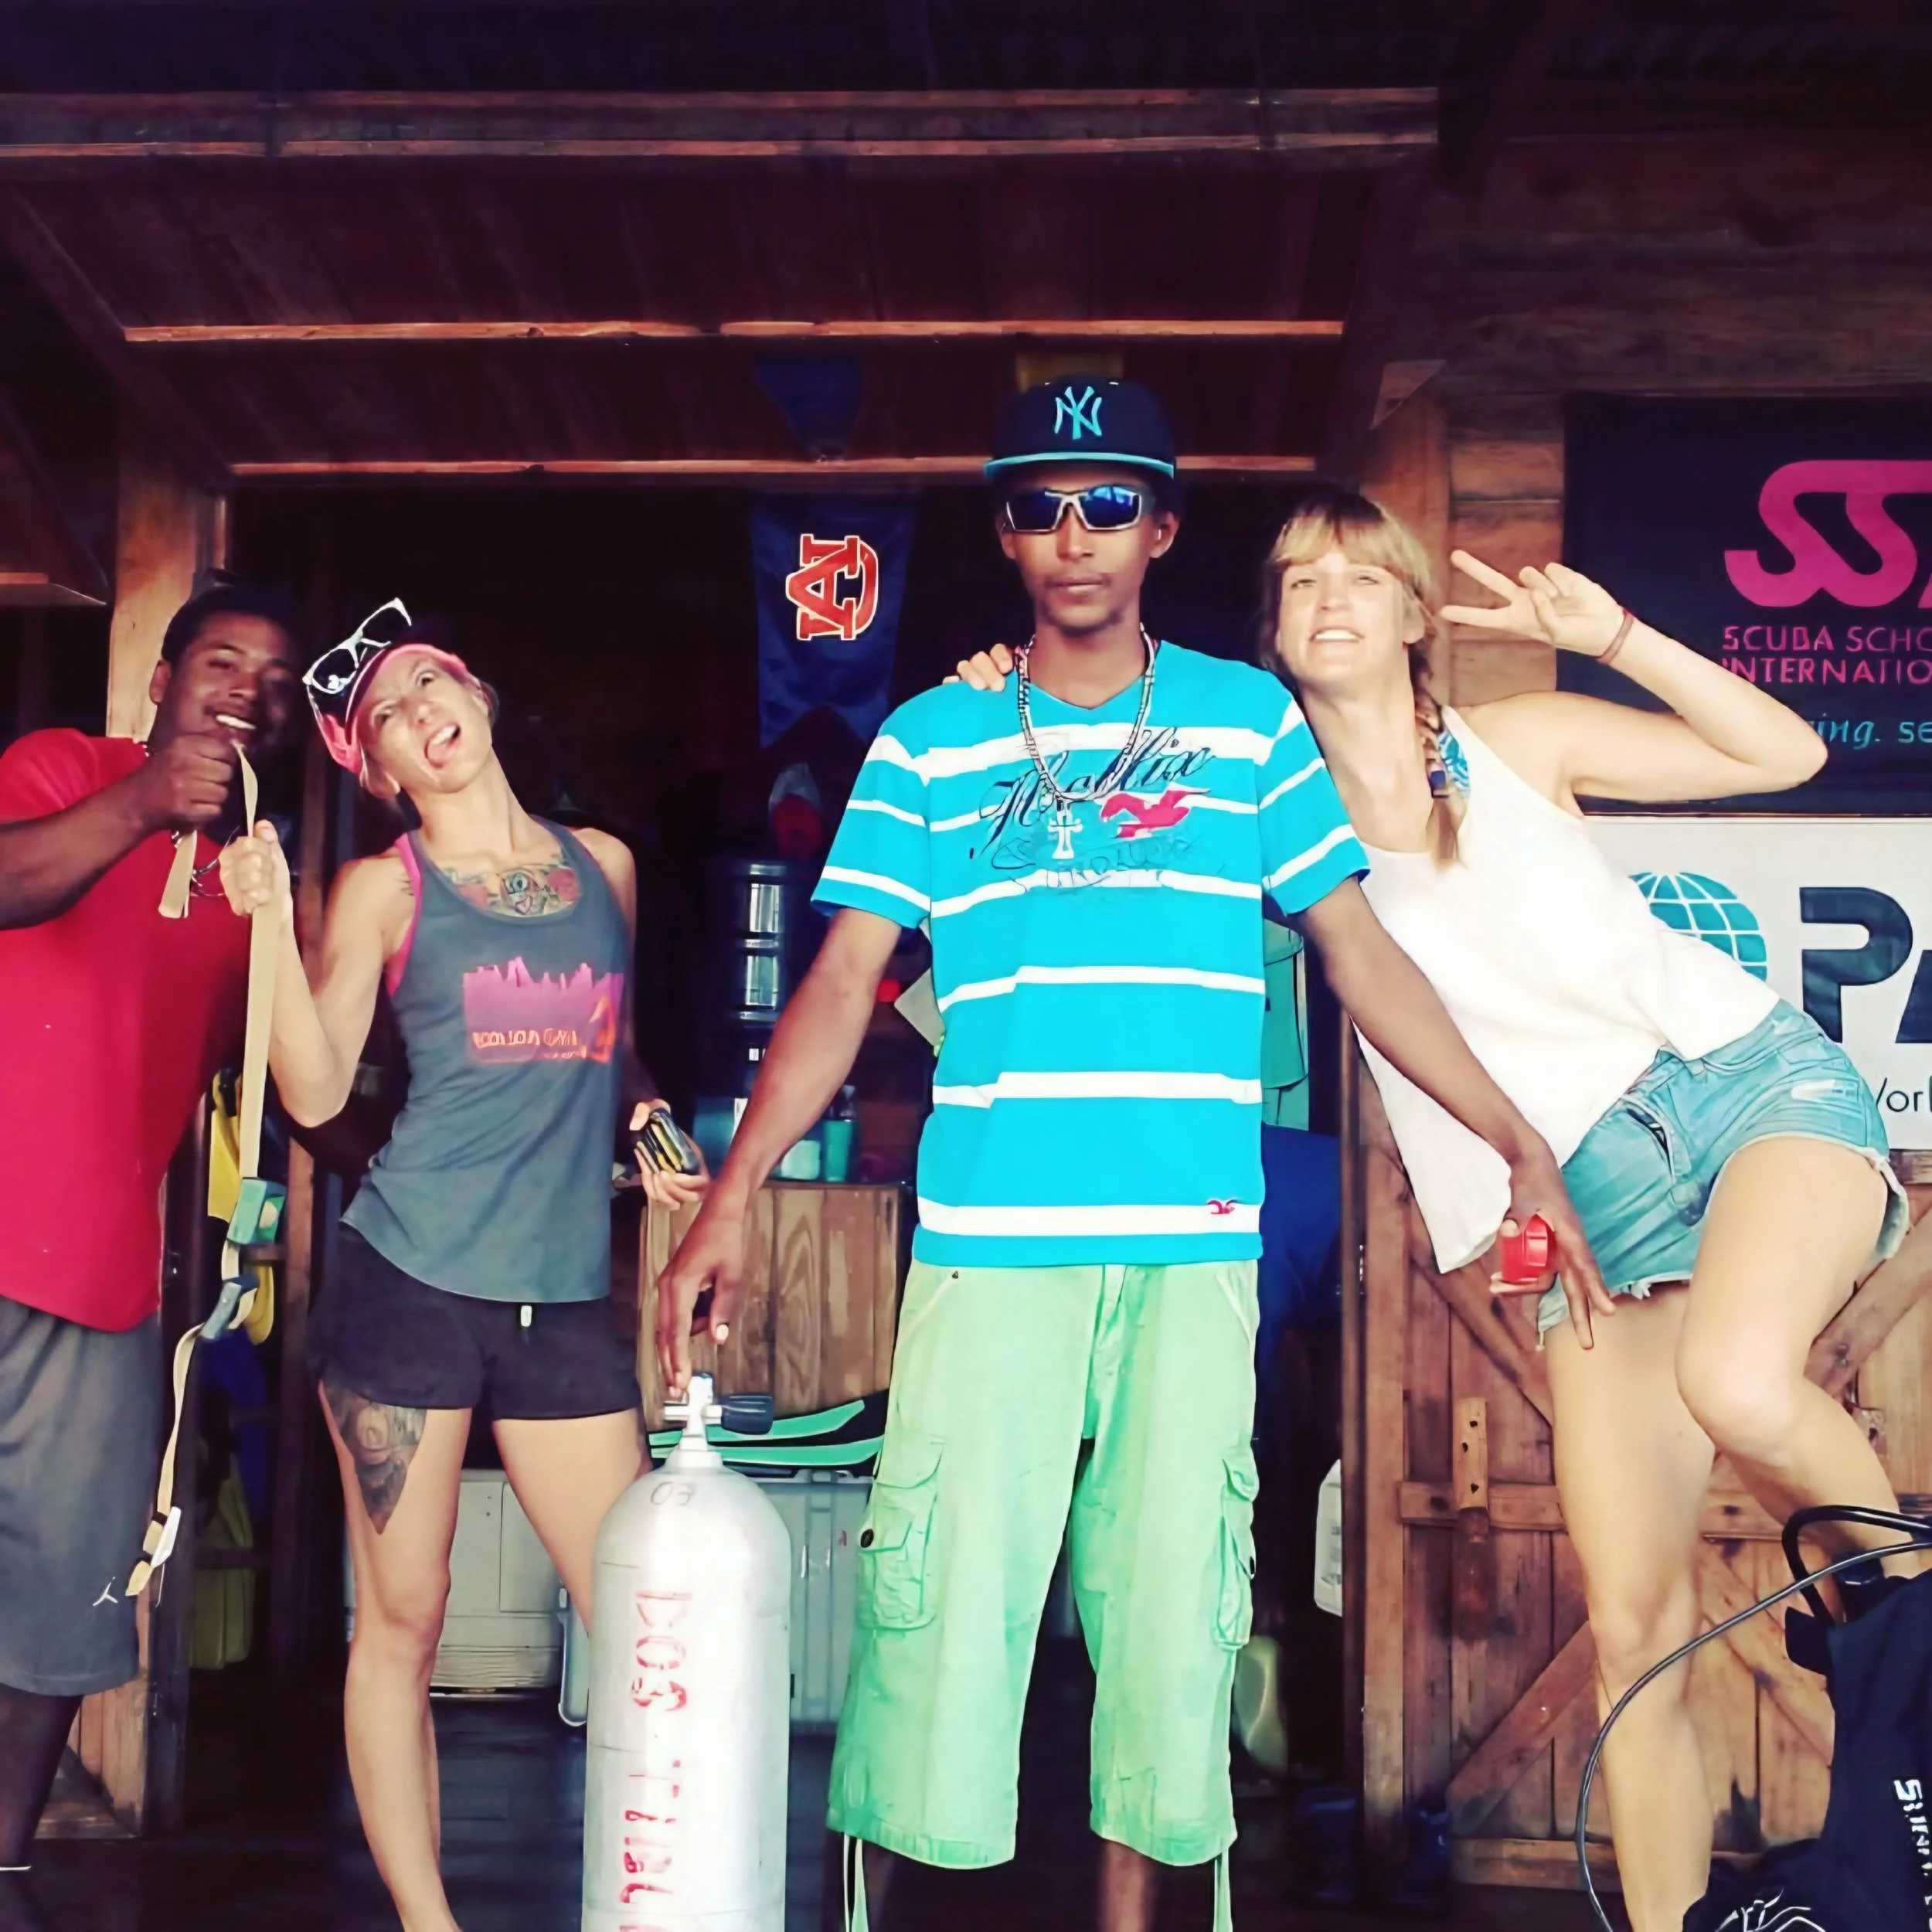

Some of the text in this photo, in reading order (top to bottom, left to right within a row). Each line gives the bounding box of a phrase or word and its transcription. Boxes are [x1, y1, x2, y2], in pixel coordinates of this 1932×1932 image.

[1054, 386, 1103, 440] NY
[1724, 459, 1932, 608] SS
[1722, 626, 1835, 651] SCUBA
